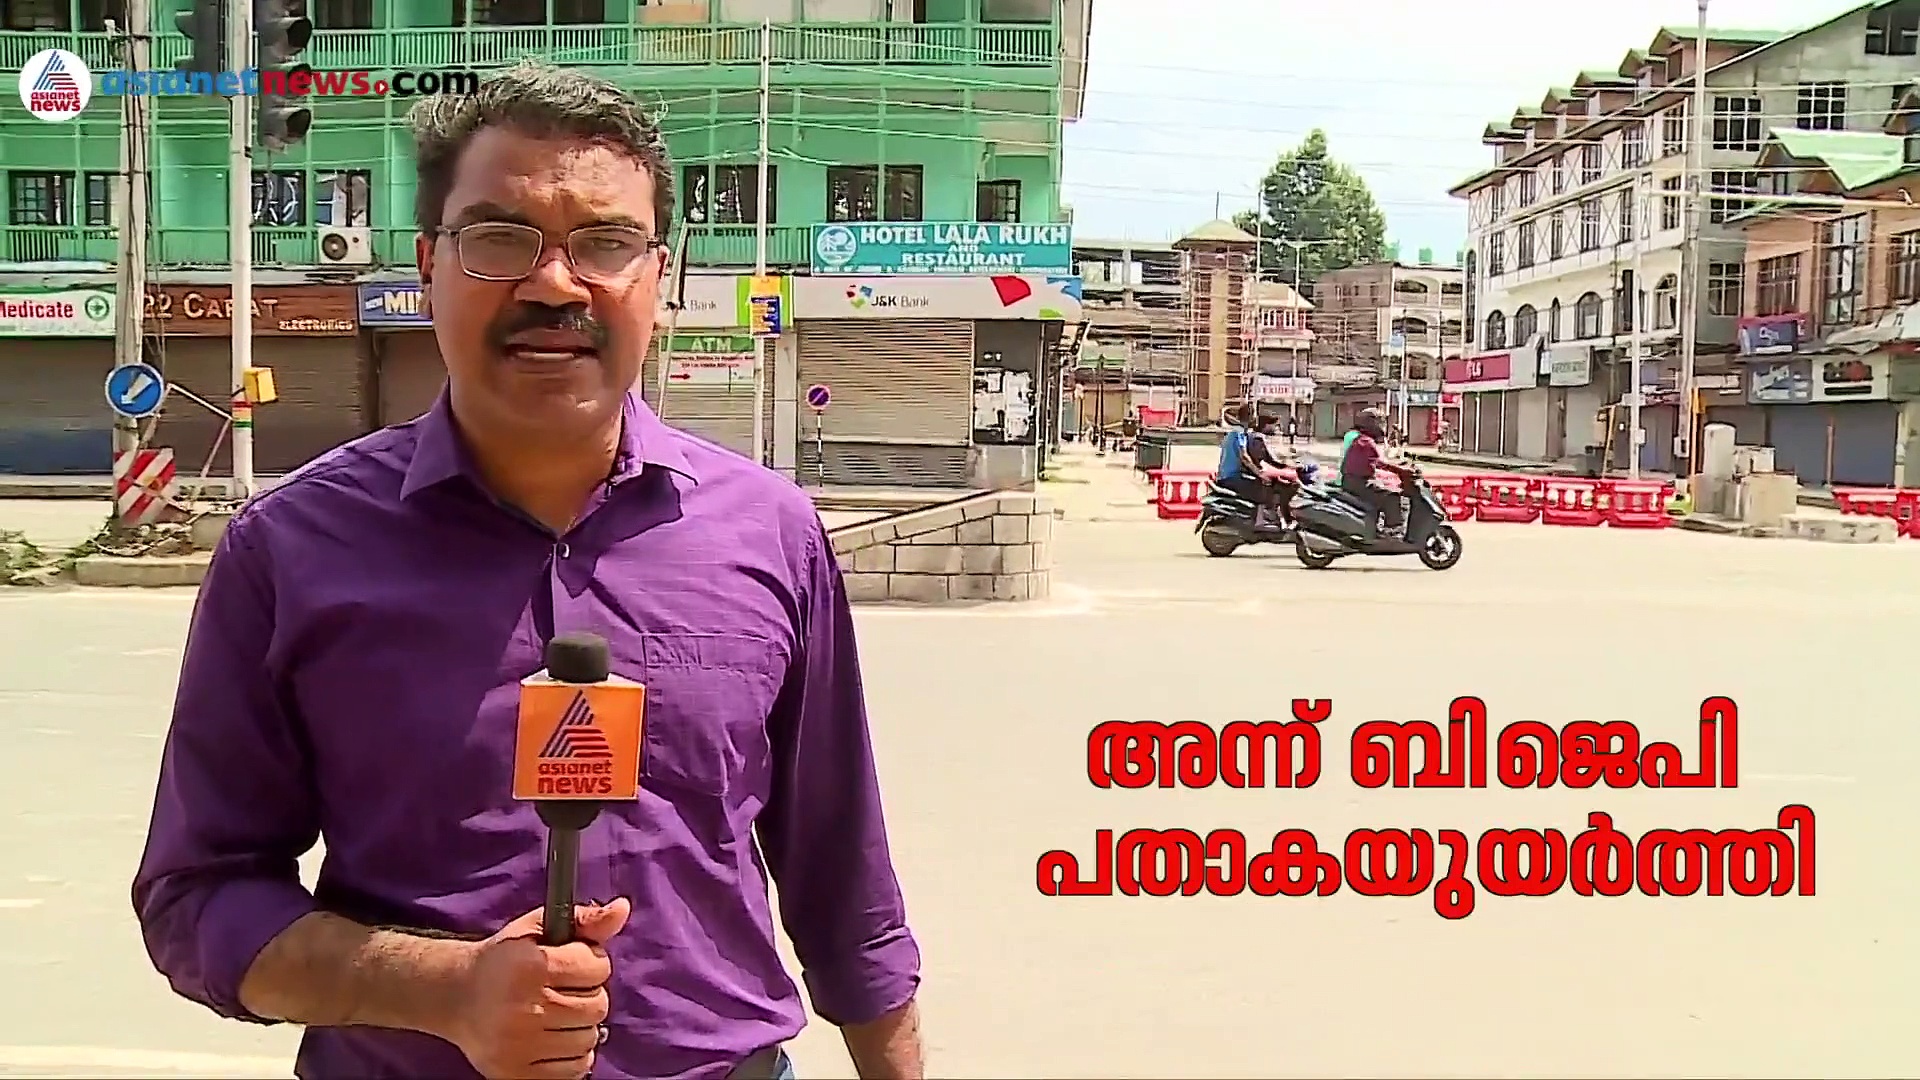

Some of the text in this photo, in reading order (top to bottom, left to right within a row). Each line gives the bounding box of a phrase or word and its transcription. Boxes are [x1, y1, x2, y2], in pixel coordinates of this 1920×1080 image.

[860, 224, 1068, 245] HOTEL LALA RUKH
[947, 244, 979, 253] AND
[901, 253, 1026, 266] RESTAURANT
[871, 295, 930, 308] J&K Bank
[691, 337, 732, 352] ATM
[537, 759, 613, 776] asianet
[537, 777, 613, 795] news
